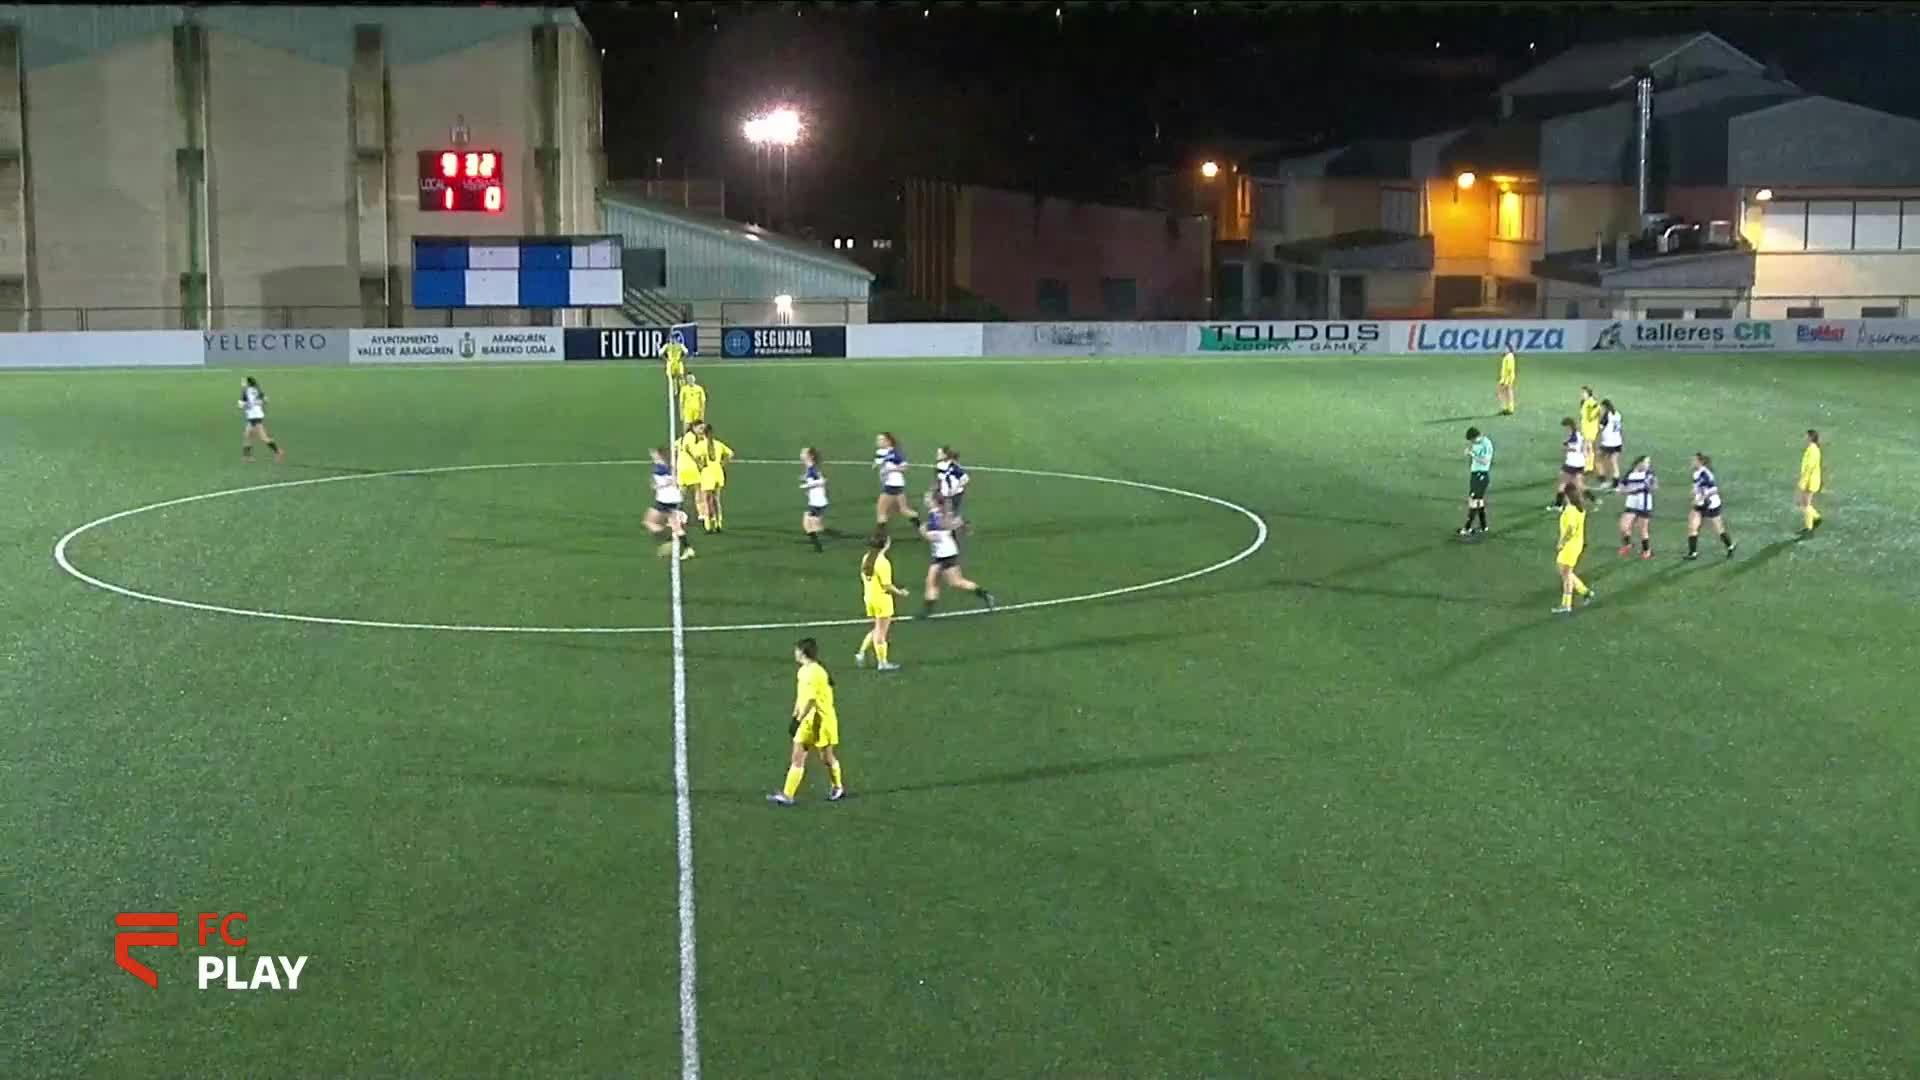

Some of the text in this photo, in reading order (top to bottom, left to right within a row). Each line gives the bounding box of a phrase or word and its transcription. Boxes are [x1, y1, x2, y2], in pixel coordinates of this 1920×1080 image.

[420, 178, 446, 191] LOCAL
[445, 186, 501, 210] 1 0
[371, 335, 439, 345] AYUNTAMIENTO
[492, 334, 546, 343] ARANGUREN
[754, 329, 812, 347] SEGUNDA
[1209, 323, 1380, 341] TOLDOS
[1417, 323, 1565, 351] Lacunza
[1636, 322, 1772, 341] talleres CR
[203, 333, 327, 350] YELECTRO
[526, 344, 556, 354] UDALA
[358, 346, 453, 356] VALLE DE ARANGUREN
